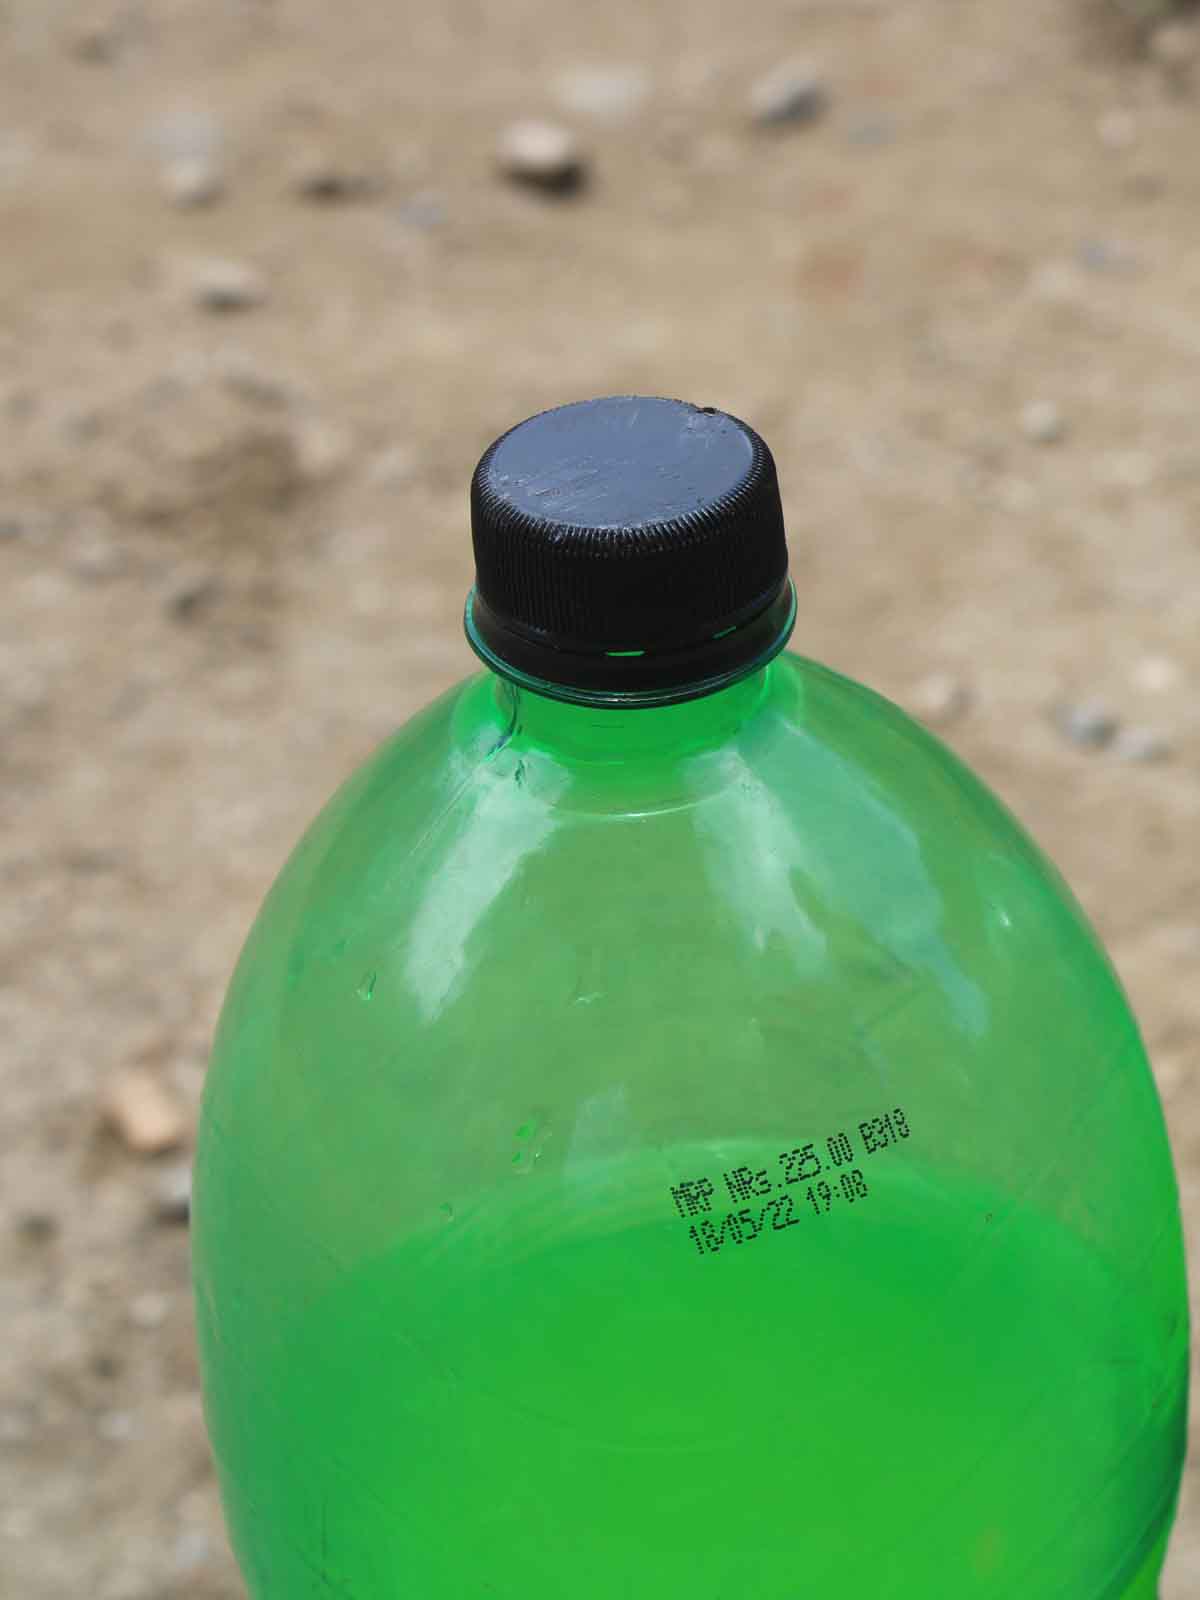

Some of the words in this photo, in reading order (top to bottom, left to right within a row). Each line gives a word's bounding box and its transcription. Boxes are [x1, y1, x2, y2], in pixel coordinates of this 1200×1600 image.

[669, 1177, 715, 1218] MRP
[857, 1107, 911, 1154] B318
[688, 1194, 800, 1255] 18/05/22
[805, 1168, 869, 1216] 19:08
